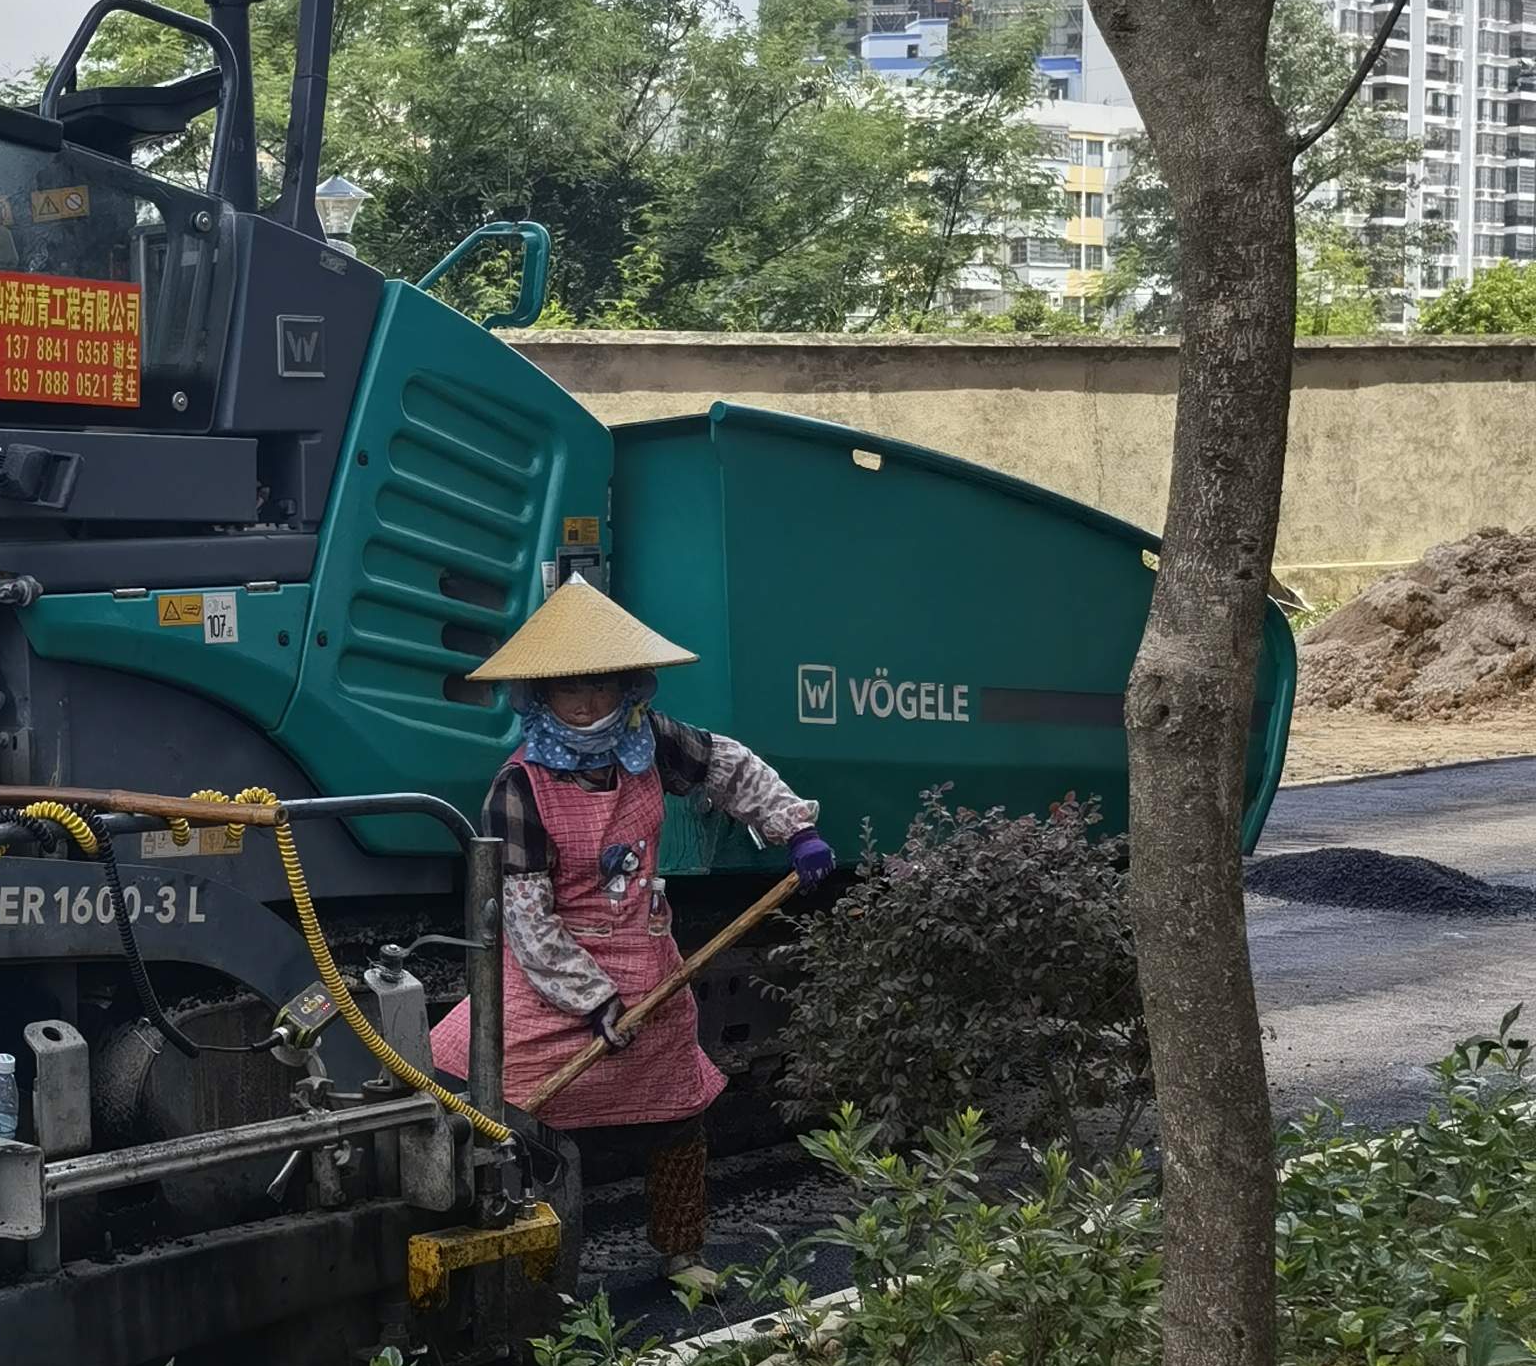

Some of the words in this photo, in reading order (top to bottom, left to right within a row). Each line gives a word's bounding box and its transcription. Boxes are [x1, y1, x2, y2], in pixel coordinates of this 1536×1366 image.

[5, 334, 30, 360] 137
[36, 337, 69, 363] 8841
[76, 339, 109, 365] 6358
[5, 367, 30, 393] 139
[36, 370, 69, 395] 7888
[76, 372, 108, 398] 0521
[207, 615, 226, 638] 107
[848, 667, 970, 723] VÖGELE
[188, 886, 206, 923] L
